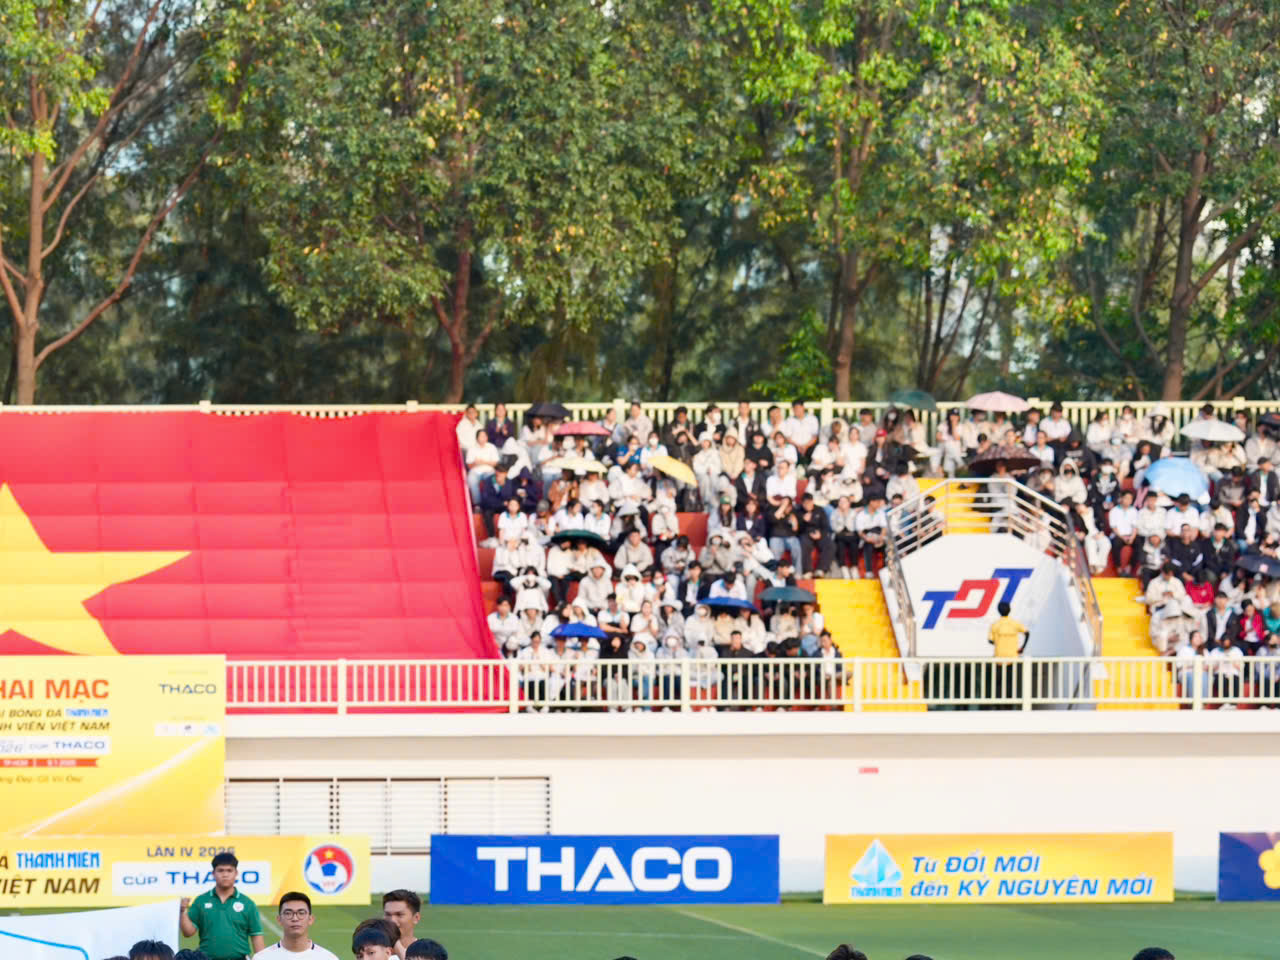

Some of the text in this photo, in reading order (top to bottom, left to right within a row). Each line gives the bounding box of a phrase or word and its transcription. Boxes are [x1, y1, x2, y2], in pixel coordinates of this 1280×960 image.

[45, 679, 109, 703] MẠC
[158, 683, 217, 694] THACO
[80, 721, 110, 731] NAM
[55, 740, 105, 750] THACO
[180, 847, 193, 857] IV
[476, 846, 733, 892] THACO
[166, 870, 260, 885] THAO
[43, 878, 100, 895] NAM
